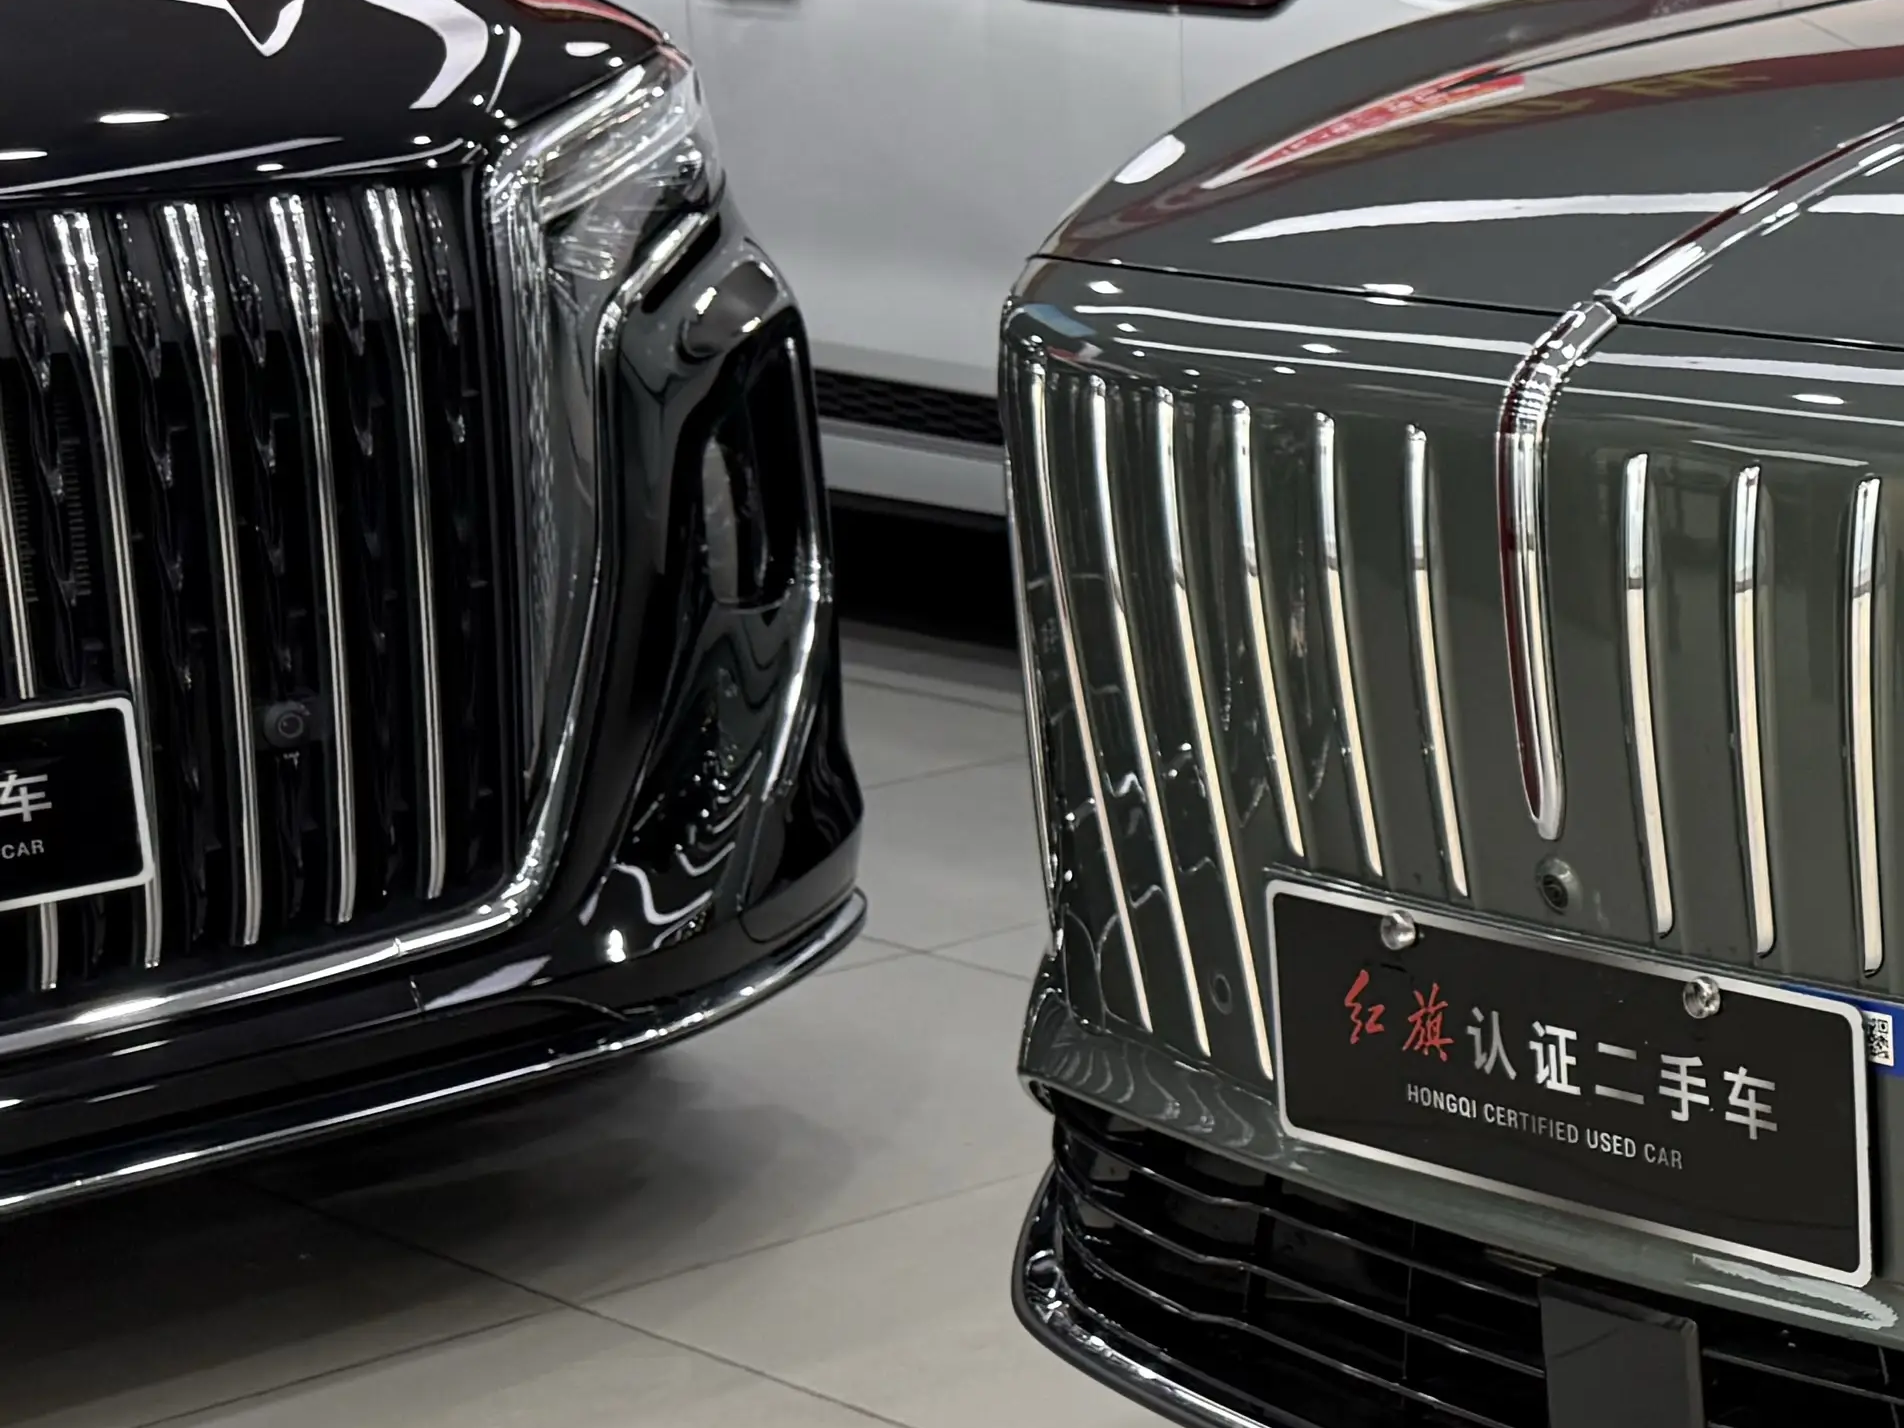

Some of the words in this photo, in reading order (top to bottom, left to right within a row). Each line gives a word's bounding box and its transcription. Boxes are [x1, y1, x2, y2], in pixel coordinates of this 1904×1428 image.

[1, 839, 45, 860] CAR
[1344, 968, 1778, 1139] 红旗认证二手车
[1407, 1083, 1477, 1119] HONGQI
[1484, 1103, 1579, 1146] CERTIFIED
[1586, 1128, 1637, 1160] USED
[1644, 1143, 1684, 1170] CAR
